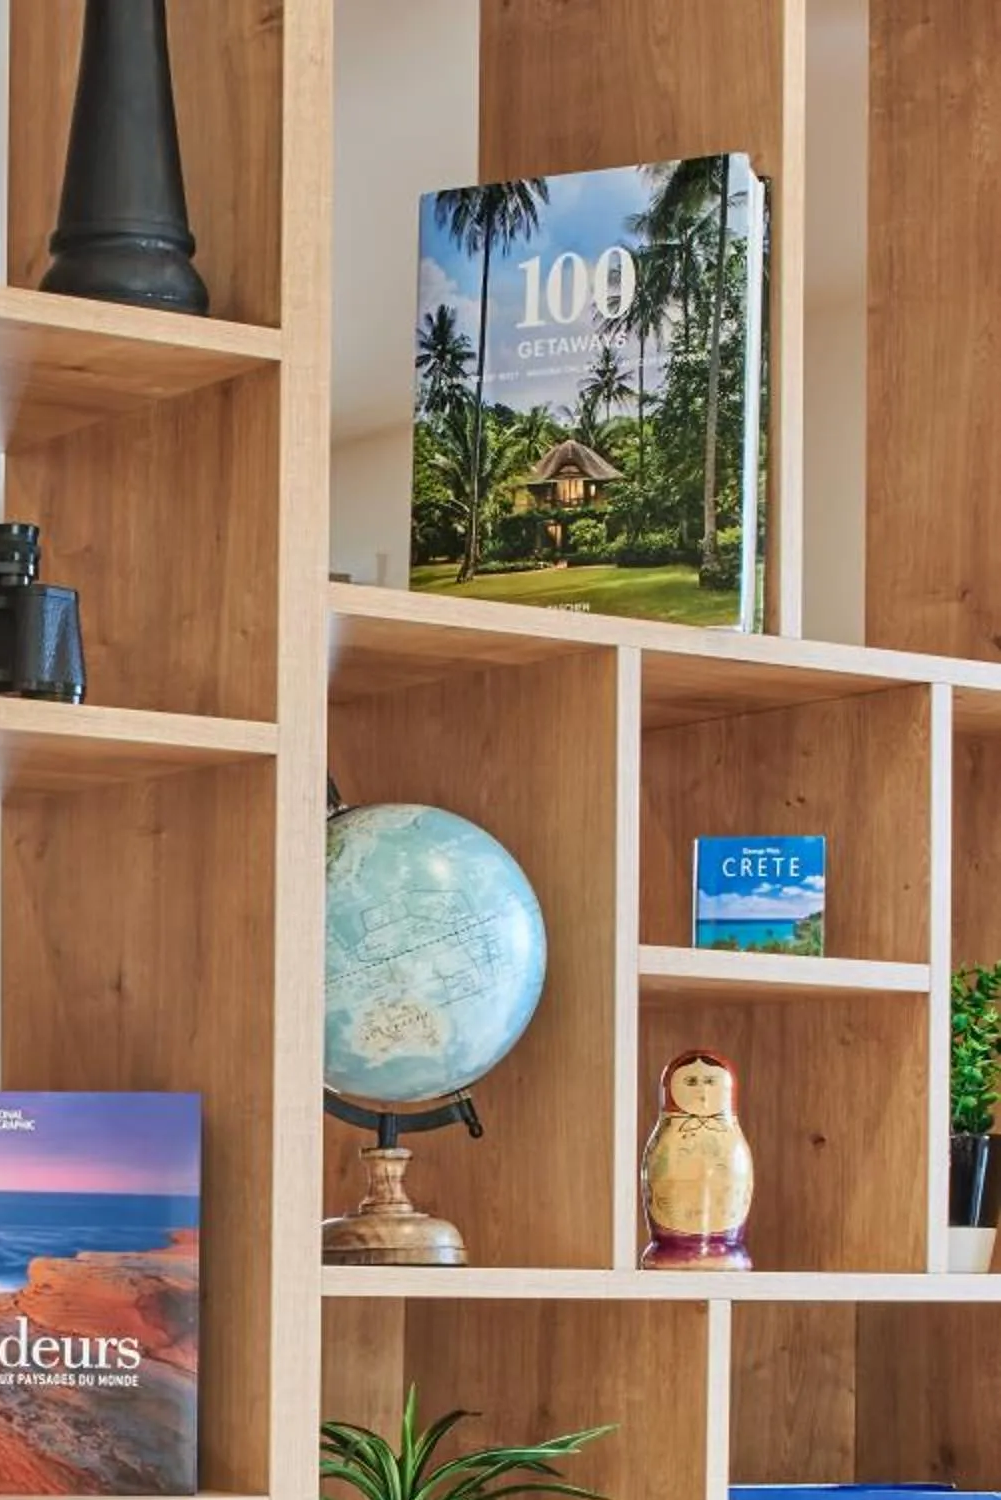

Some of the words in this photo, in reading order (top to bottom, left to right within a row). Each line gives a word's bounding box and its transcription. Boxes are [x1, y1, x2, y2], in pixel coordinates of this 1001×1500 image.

[515, 246, 637, 329] 100
[518, 331, 628, 360] GETAWAYS
[722, 857, 801, 877] CRETE
[17, 1373, 75, 1386] PAYSAGES
[78, 1375, 95, 1387] DU
[99, 1375, 139, 1387] MONDE
